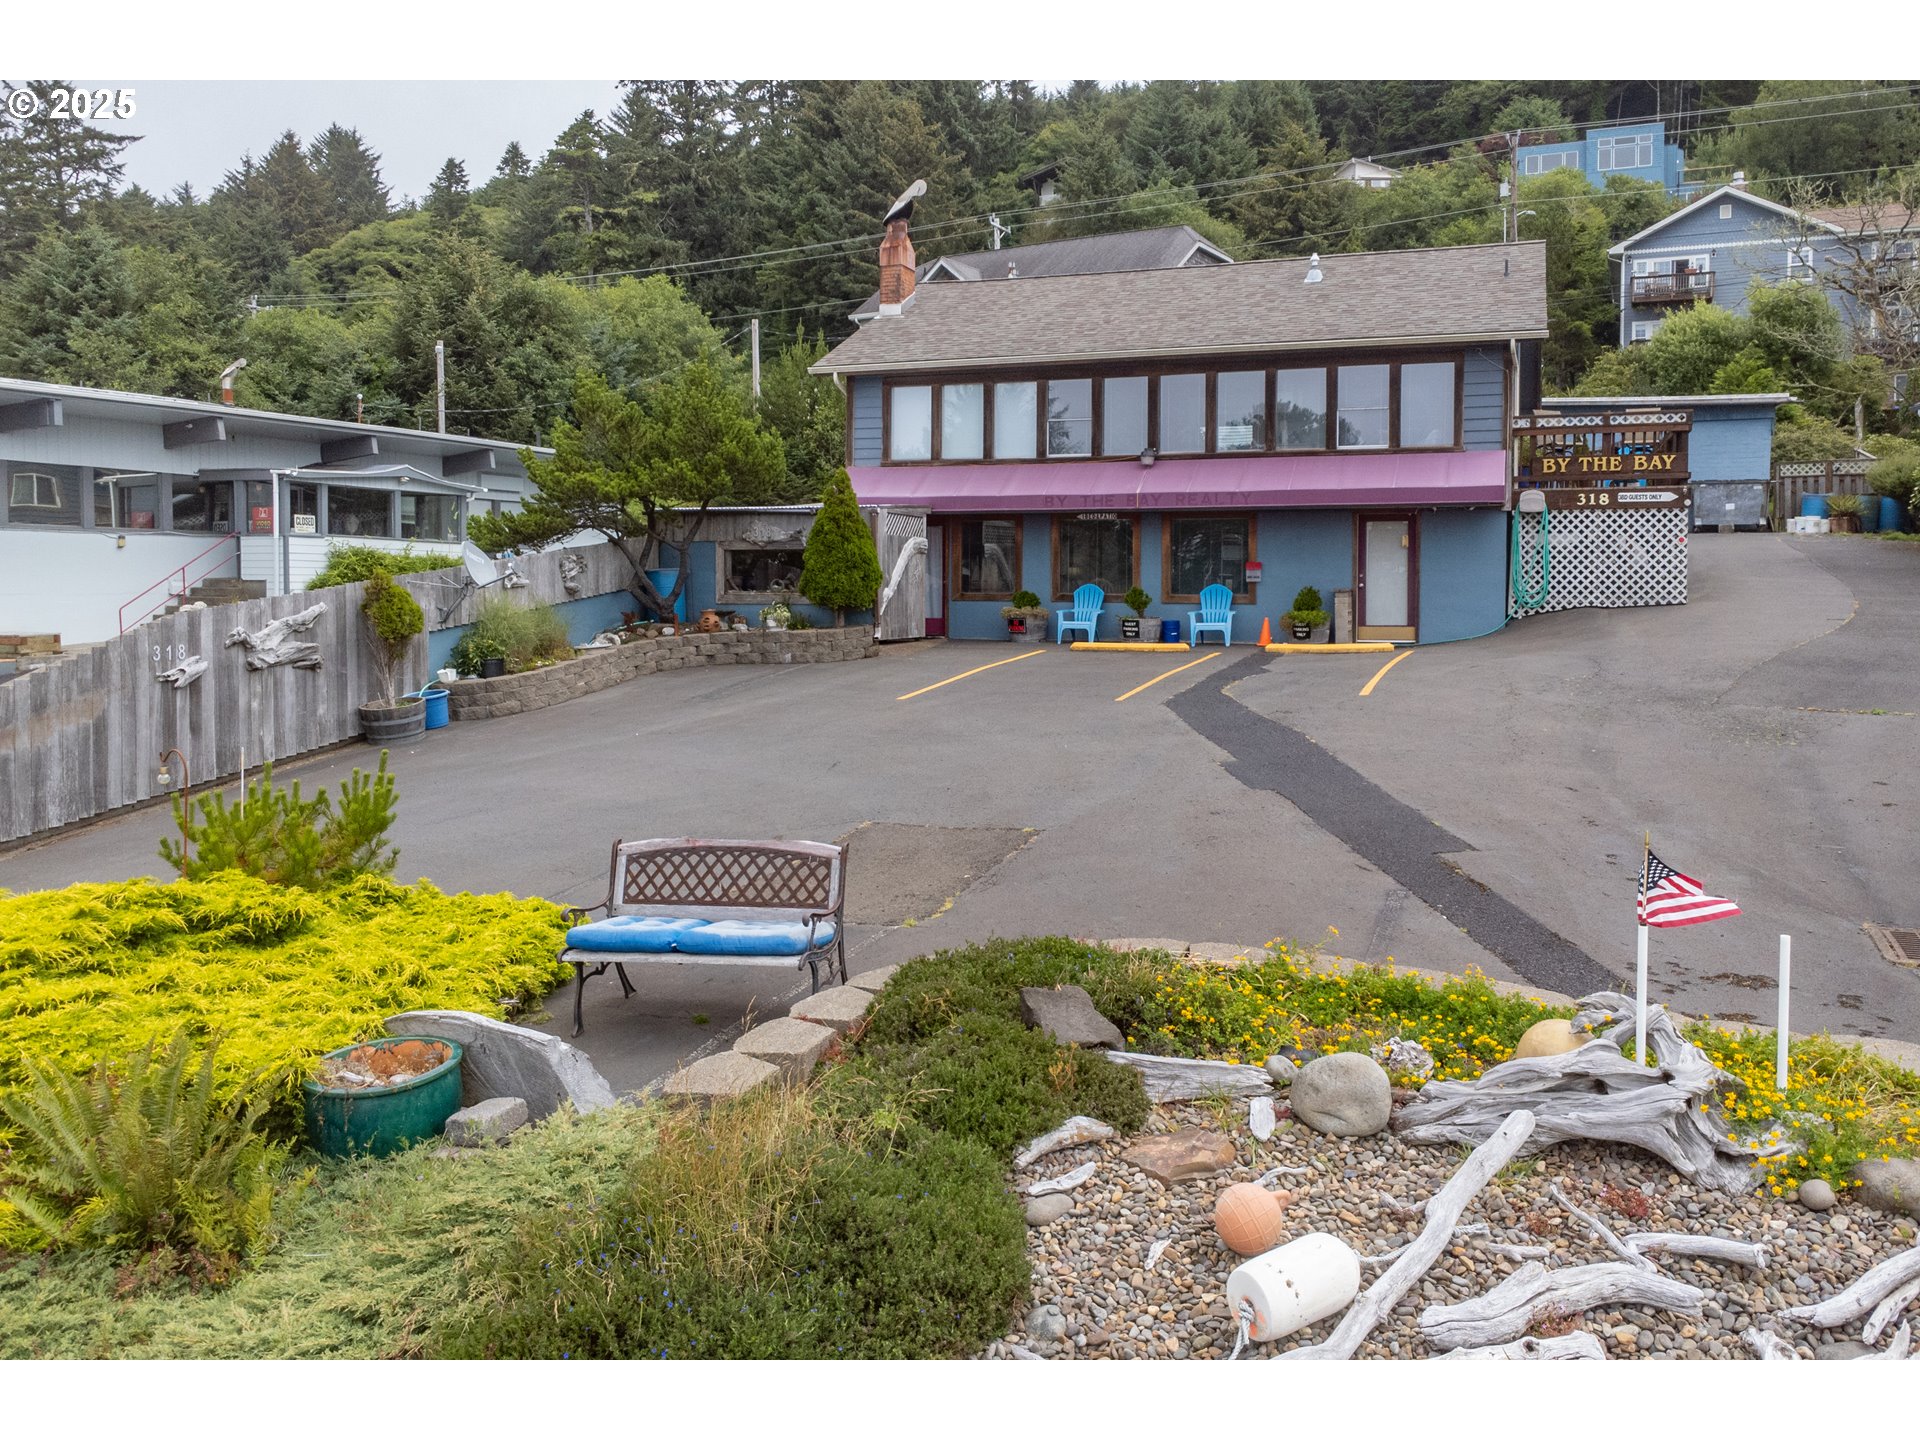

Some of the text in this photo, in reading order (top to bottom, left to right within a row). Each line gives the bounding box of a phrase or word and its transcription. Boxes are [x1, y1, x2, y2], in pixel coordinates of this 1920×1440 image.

[1541, 454, 1677, 474] BY THE BAY
[1043, 492, 1252, 508] BY THE BAY REALTY
[1576, 493, 1610, 506] 318
[295, 516, 315, 527] CLOSED
[152, 643, 187, 662] 318
